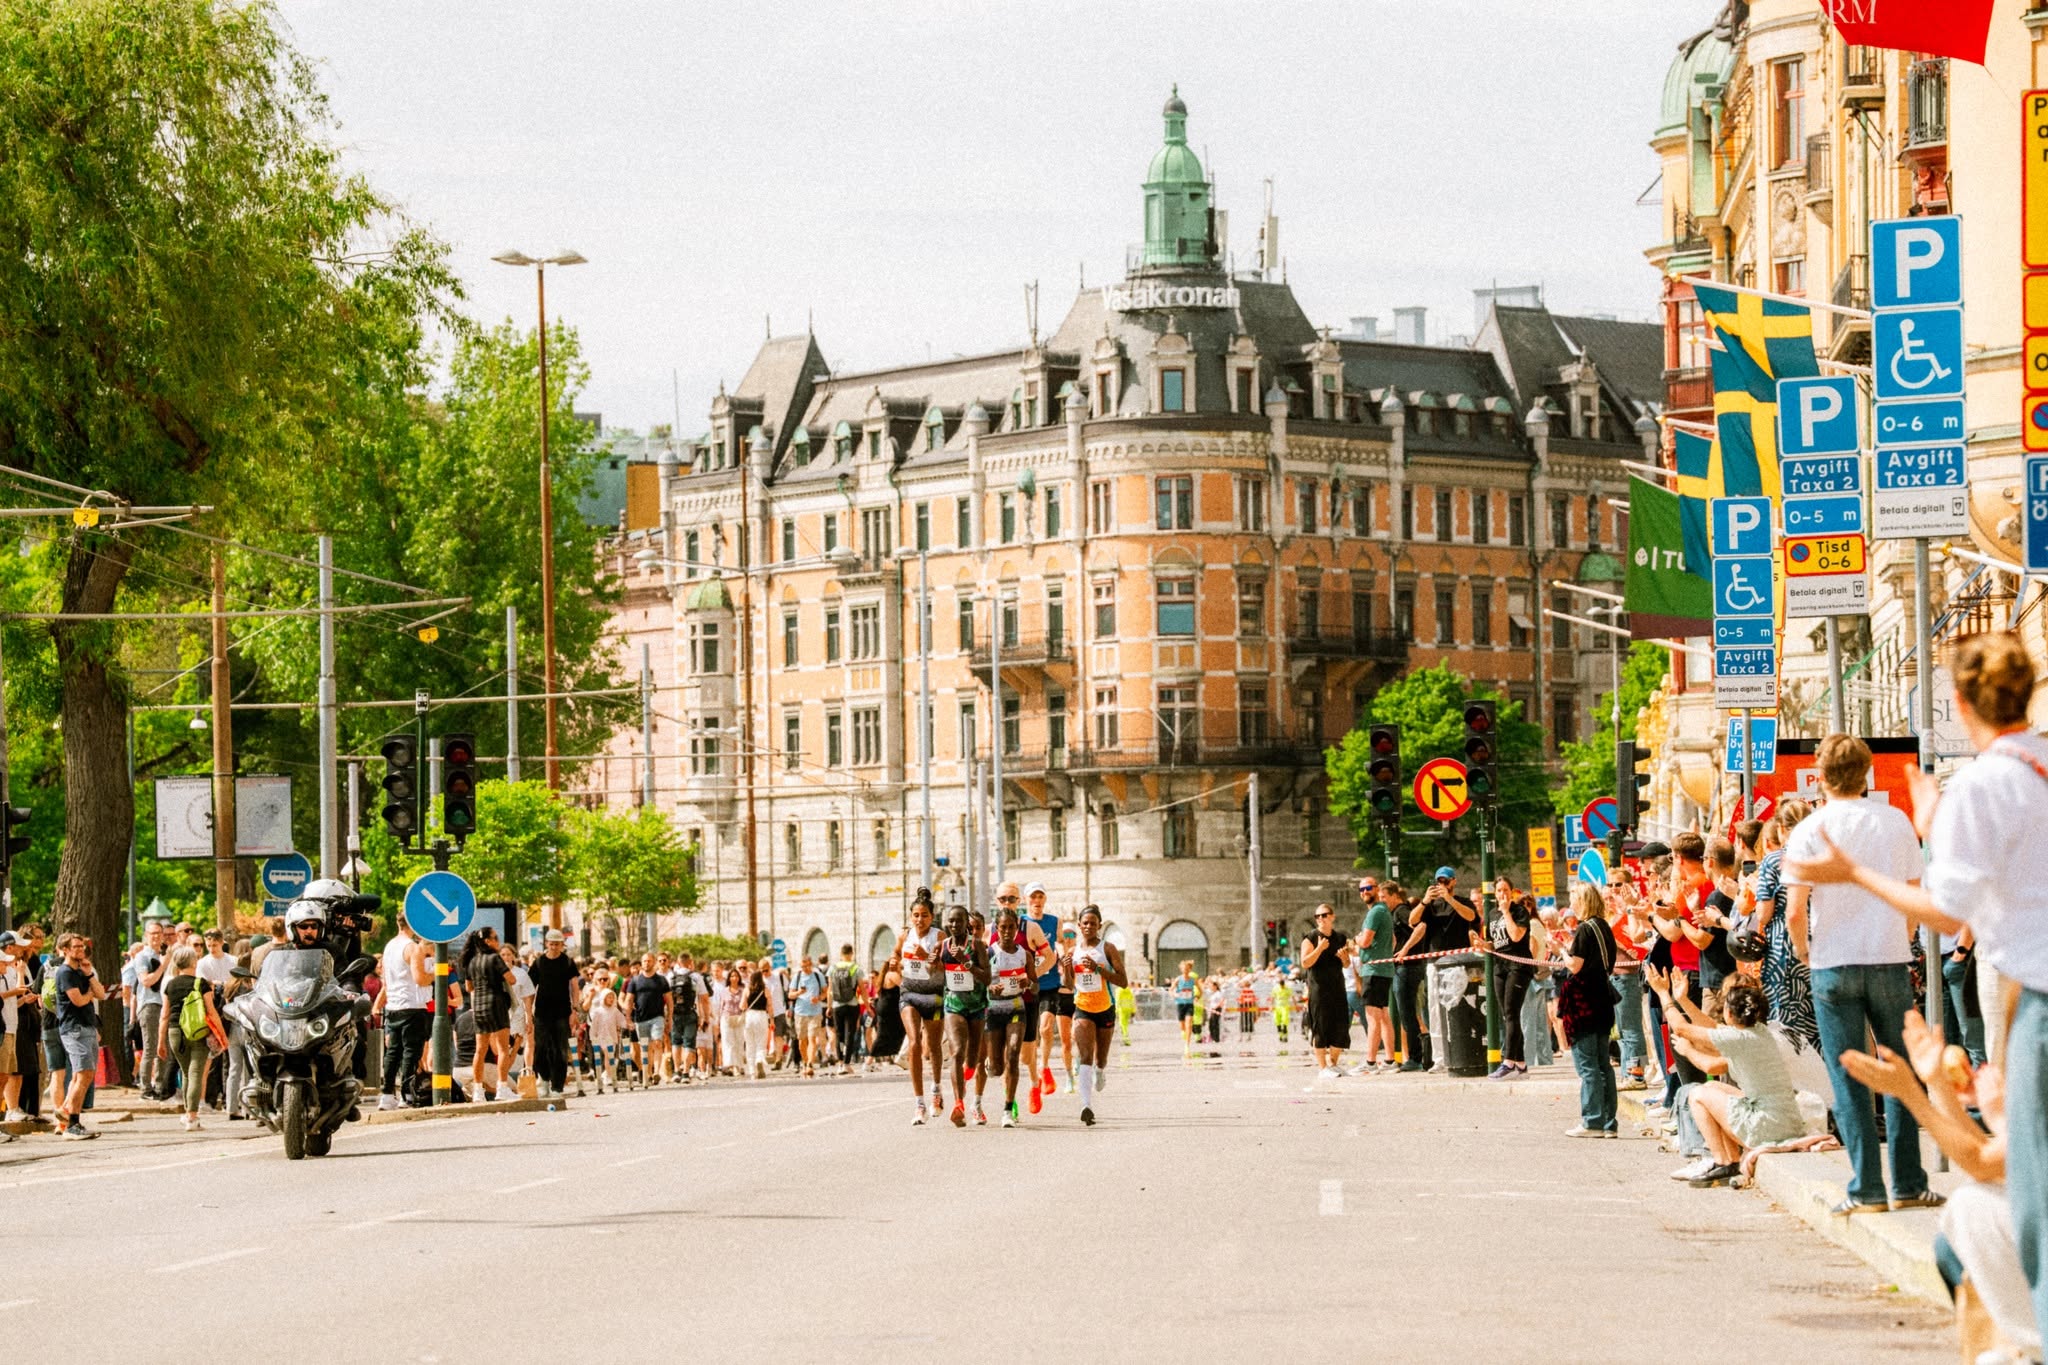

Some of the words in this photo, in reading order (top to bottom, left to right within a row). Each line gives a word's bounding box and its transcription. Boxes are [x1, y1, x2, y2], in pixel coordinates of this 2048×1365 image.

[1895, 228, 1945, 298] P
[1102, 282, 1240, 311] Vasakronan
[1800, 386, 1843, 447] P
[1882, 416, 1924, 432] 0-6
[1943, 416, 1958, 429] m
[1888, 450, 1953, 470] Avgift
[1792, 460, 1850, 478] Avgift
[1790, 479, 1835, 493] Taxa
[1843, 476, 1854, 489] 2
[1884, 471, 1936, 487] Taxa
[1945, 469, 1957, 484] 2
[83, 513, 89, 522] 2
[1789, 510, 1824, 524] 0-5
[1843, 510, 1857, 521] m
[1728, 504, 1761, 550] P
[1816, 540, 1850, 554] Tisd
[1818, 555, 1851, 569] 0-6
[1718, 627, 1744, 638] 0-5
[1760, 628, 1771, 637] m
[1724, 651, 1768, 664] Avgift
[1722, 664, 1756, 674] Taxa
[1762, 663, 1770, 674] 2
[1760, 740, 1773, 750] tid
[1760, 760, 1767, 769] 2
[911, 961, 922, 969] 200
